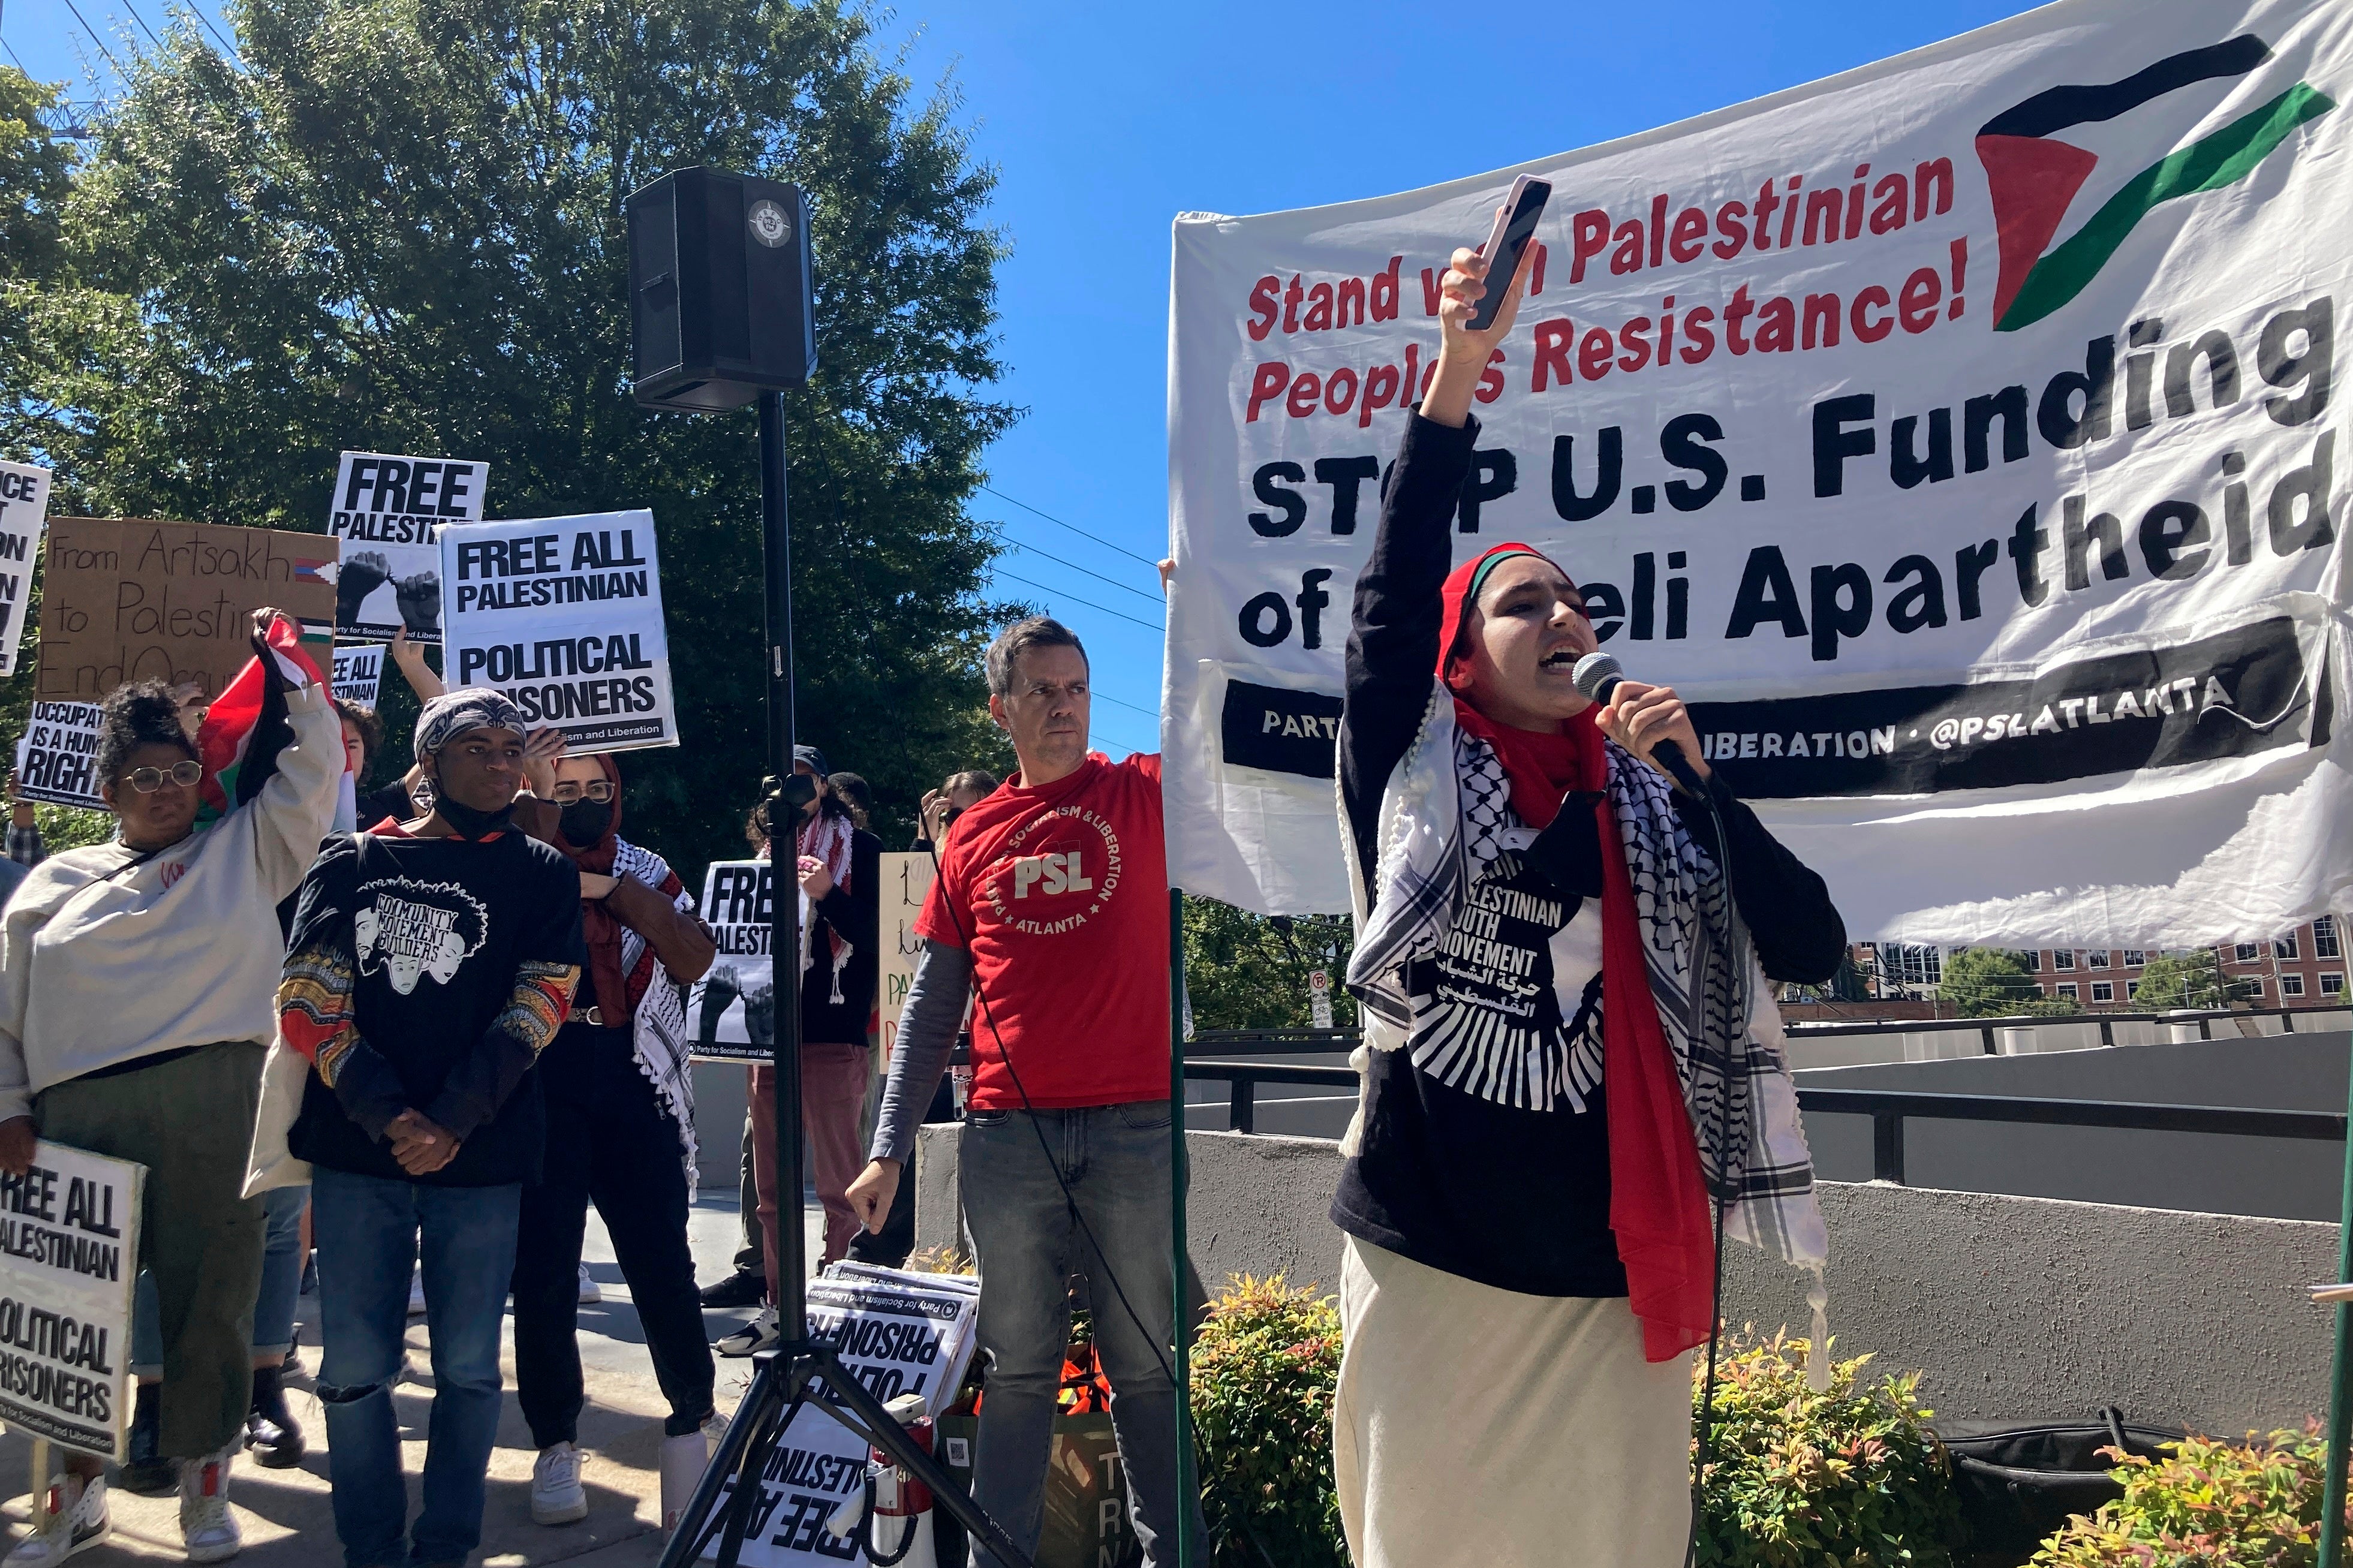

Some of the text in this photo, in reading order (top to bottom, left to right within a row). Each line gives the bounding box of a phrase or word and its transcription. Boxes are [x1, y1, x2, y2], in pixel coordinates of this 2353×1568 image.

[1247, 255, 1403, 341] Stand
[1570, 157, 1954, 284] Palestinian
[1531, 234, 1968, 392] Resistance!
[1248, 295, 2334, 538] STP U.S. Funding
[345, 458, 473, 517] FREE
[333, 512, 473, 544] PALESTI
[1238, 568, 1333, 650] of
[1725, 428, 2335, 661] Apartheid
[52, 535, 118, 570] From
[137, 528, 290, 582] Artsakh
[458, 529, 645, 580] FREE ALL
[458, 570, 648, 613] PALESTINIAN
[54, 598, 89, 633] to
[335, 627, 347, 635] arty
[417, 631, 442, 640] Libera
[332, 655, 377, 682] EE ALL
[460, 633, 652, 685] POLITICAL
[495, 676, 655, 723] ISONERS
[1262, 675, 2235, 760] PART IBERATION @PSLATLANTA
[32, 726, 101, 755] IS A HUM
[585, 730, 605, 739] and
[607, 726, 659, 737] Liberation
[1009, 806, 1121, 935] SOCIALISM & LIBERATION ATLANTA
[1015, 851, 1093, 899] PSL
[379, 895, 458, 929] COMMUNITY
[709, 867, 801, 923] FRE
[1469, 884, 1561, 928] LESTINIAN
[378, 911, 449, 946] MOVEMENT
[379, 930, 440, 963] BUILDERS
[1436, 983, 1536, 1018] الفلسطيني
[1497, 971, 1540, 999] حركة
[697, 1046, 710, 1054] Party
[720, 1047, 746, 1055] Socialism
[0, 1165, 121, 1238] REE ALL
[0, 1218, 119, 1281] ALESTINIAN
[810, 1289, 848, 1304] Liberation
[851, 1293, 865, 1304] and
[866, 1295, 903, 1308] Socialism
[905, 1300, 917, 1311] for
[918, 1300, 940, 1313] Party
[0, 1297, 113, 1376] OLITICAL
[0, 1350, 111, 1422] RISONERS
